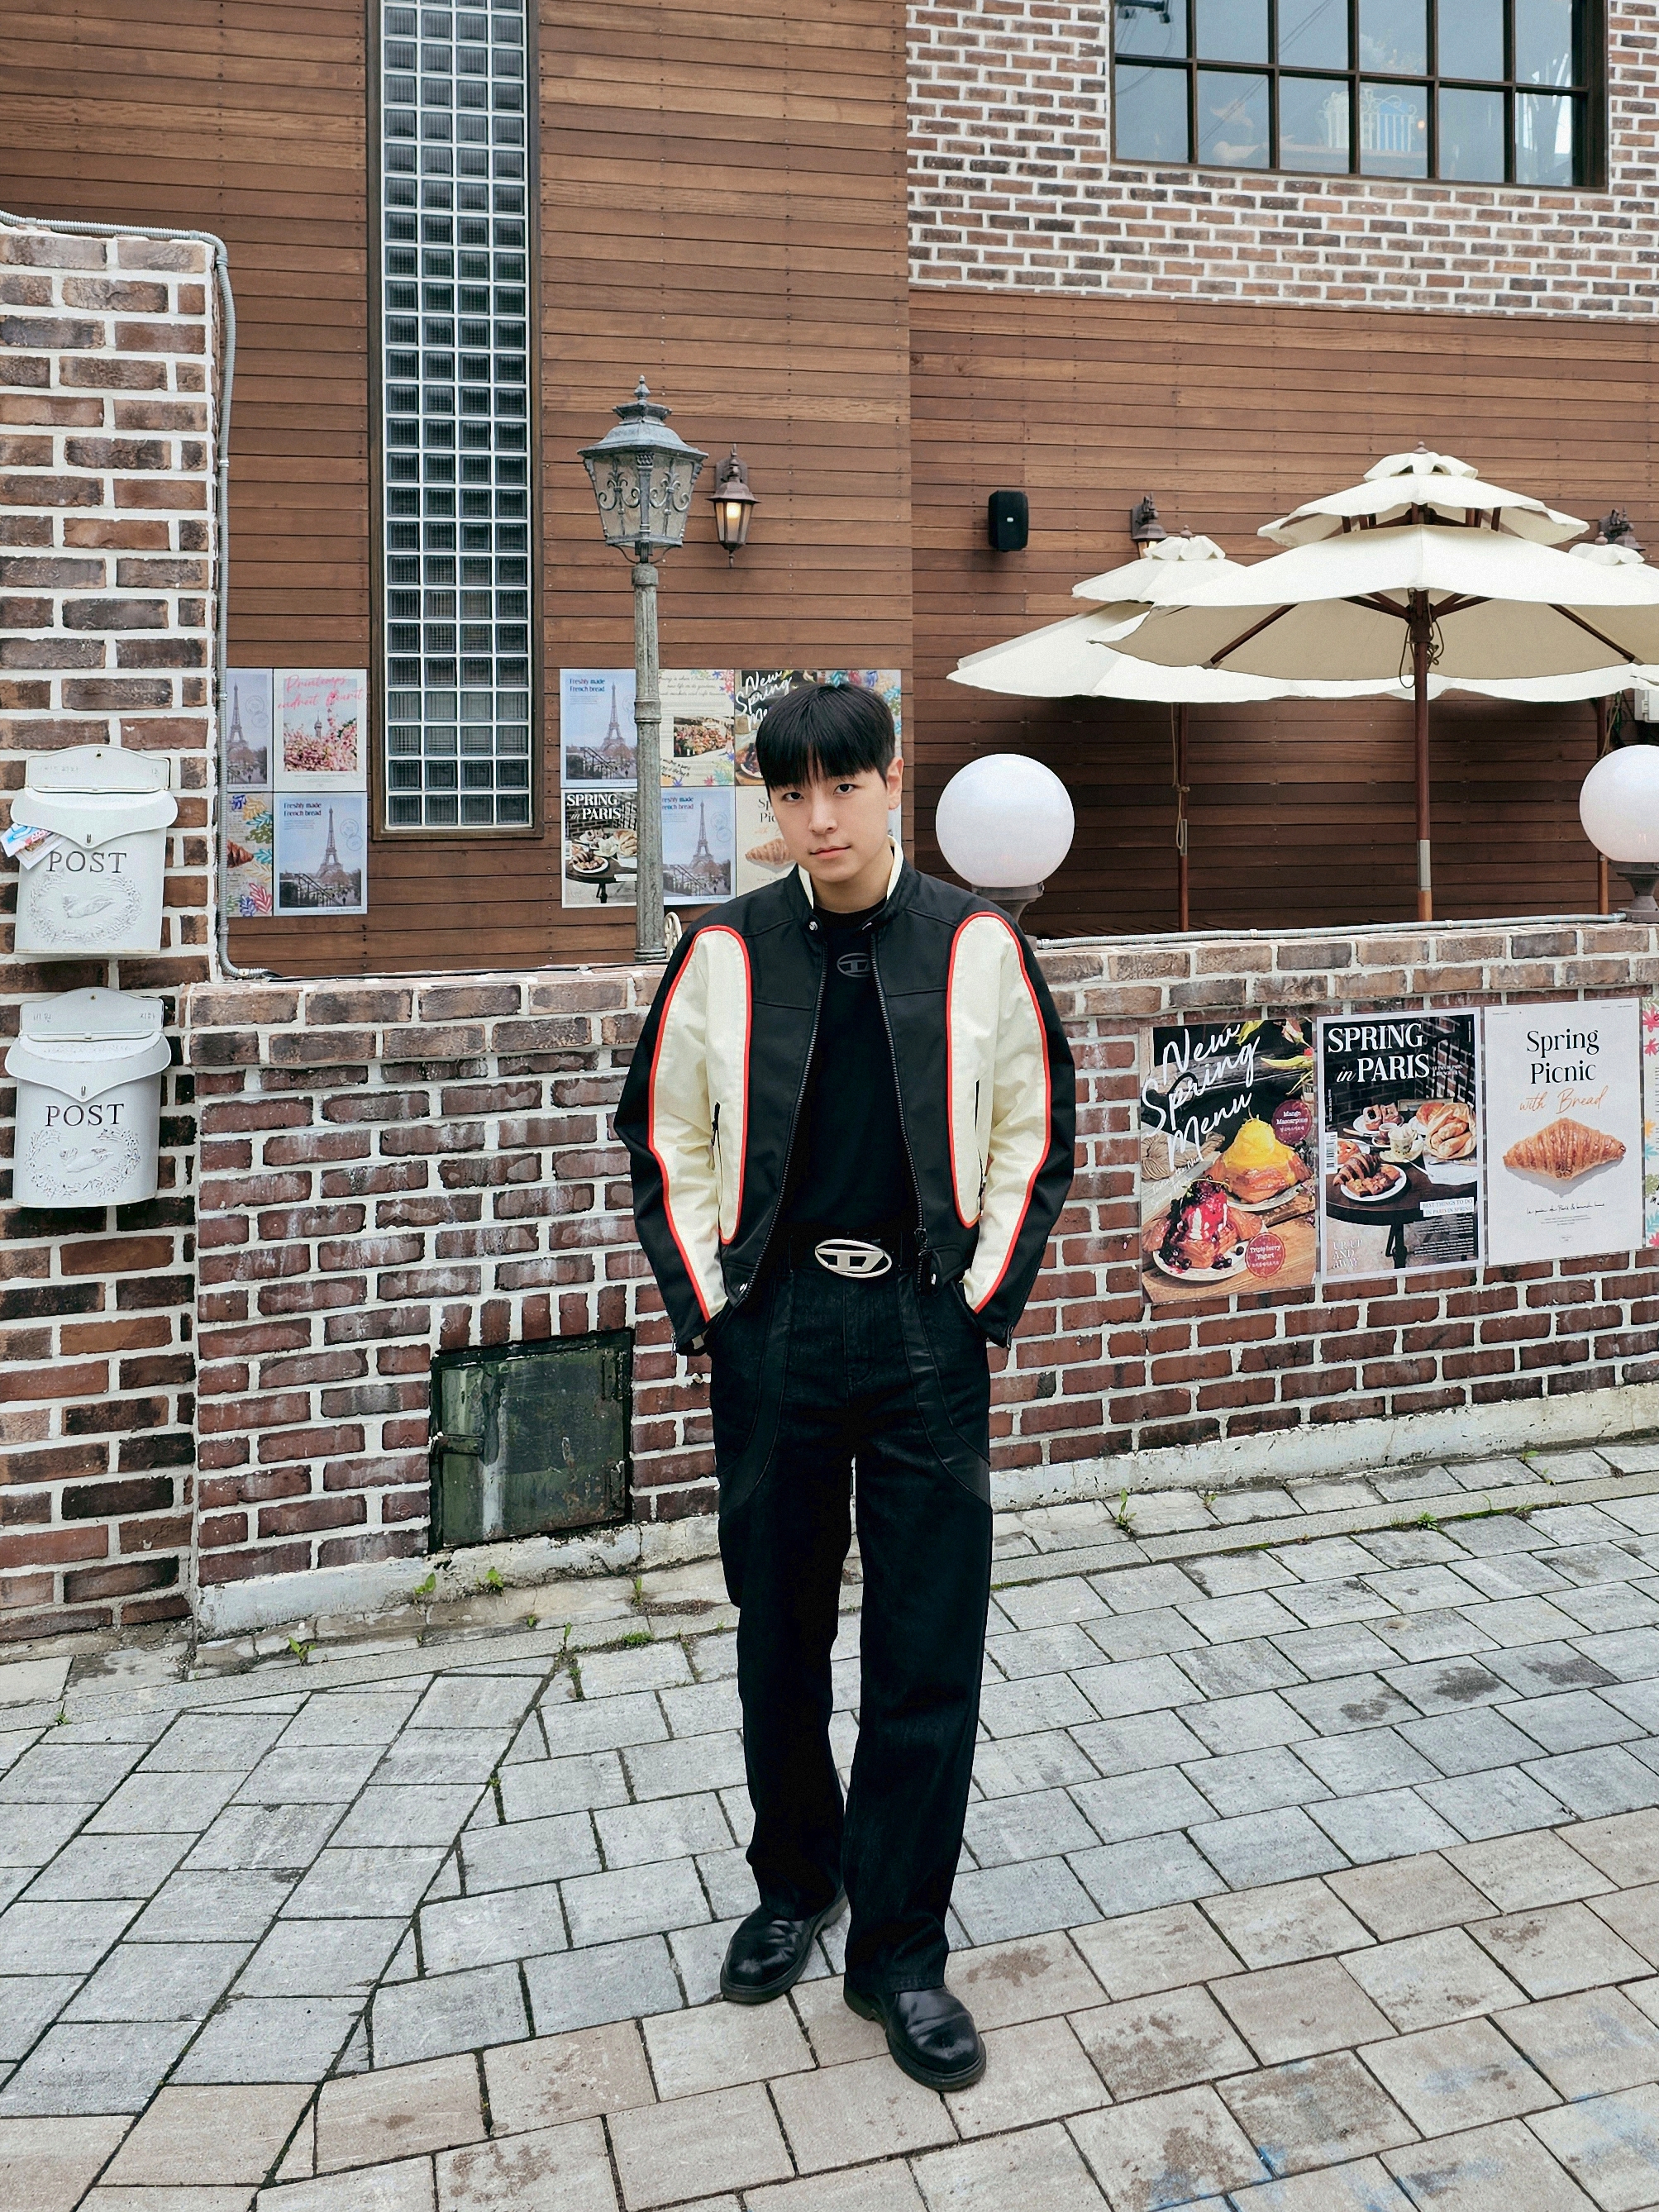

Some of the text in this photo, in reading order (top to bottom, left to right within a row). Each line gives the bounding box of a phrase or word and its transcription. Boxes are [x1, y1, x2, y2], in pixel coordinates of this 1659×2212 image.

[745, 671, 783, 695] New
[735, 676, 793, 717] Spring
[566, 794, 617, 807] SPRING
[582, 808, 622, 820] PARIS
[760, 812, 775, 823] Pic
[46, 851, 127, 874] POST
[1328, 1023, 1423, 1053] SPRING
[1527, 1028, 1599, 1058] Spring
[1163, 1024, 1240, 1086] New
[1336, 1065, 1356, 1083] in
[1356, 1053, 1430, 1083] PARIS
[1531, 1061, 1596, 1085] Picnic
[1142, 1037, 1261, 1137] Spring
[1519, 1085, 1609, 1114] with Bread
[45, 1104, 125, 1127] POST
[1167, 1092, 1252, 1172] Menu
[1332, 1249, 1355, 1260] AND
[1332, 1257, 1360, 1269] AWAY
